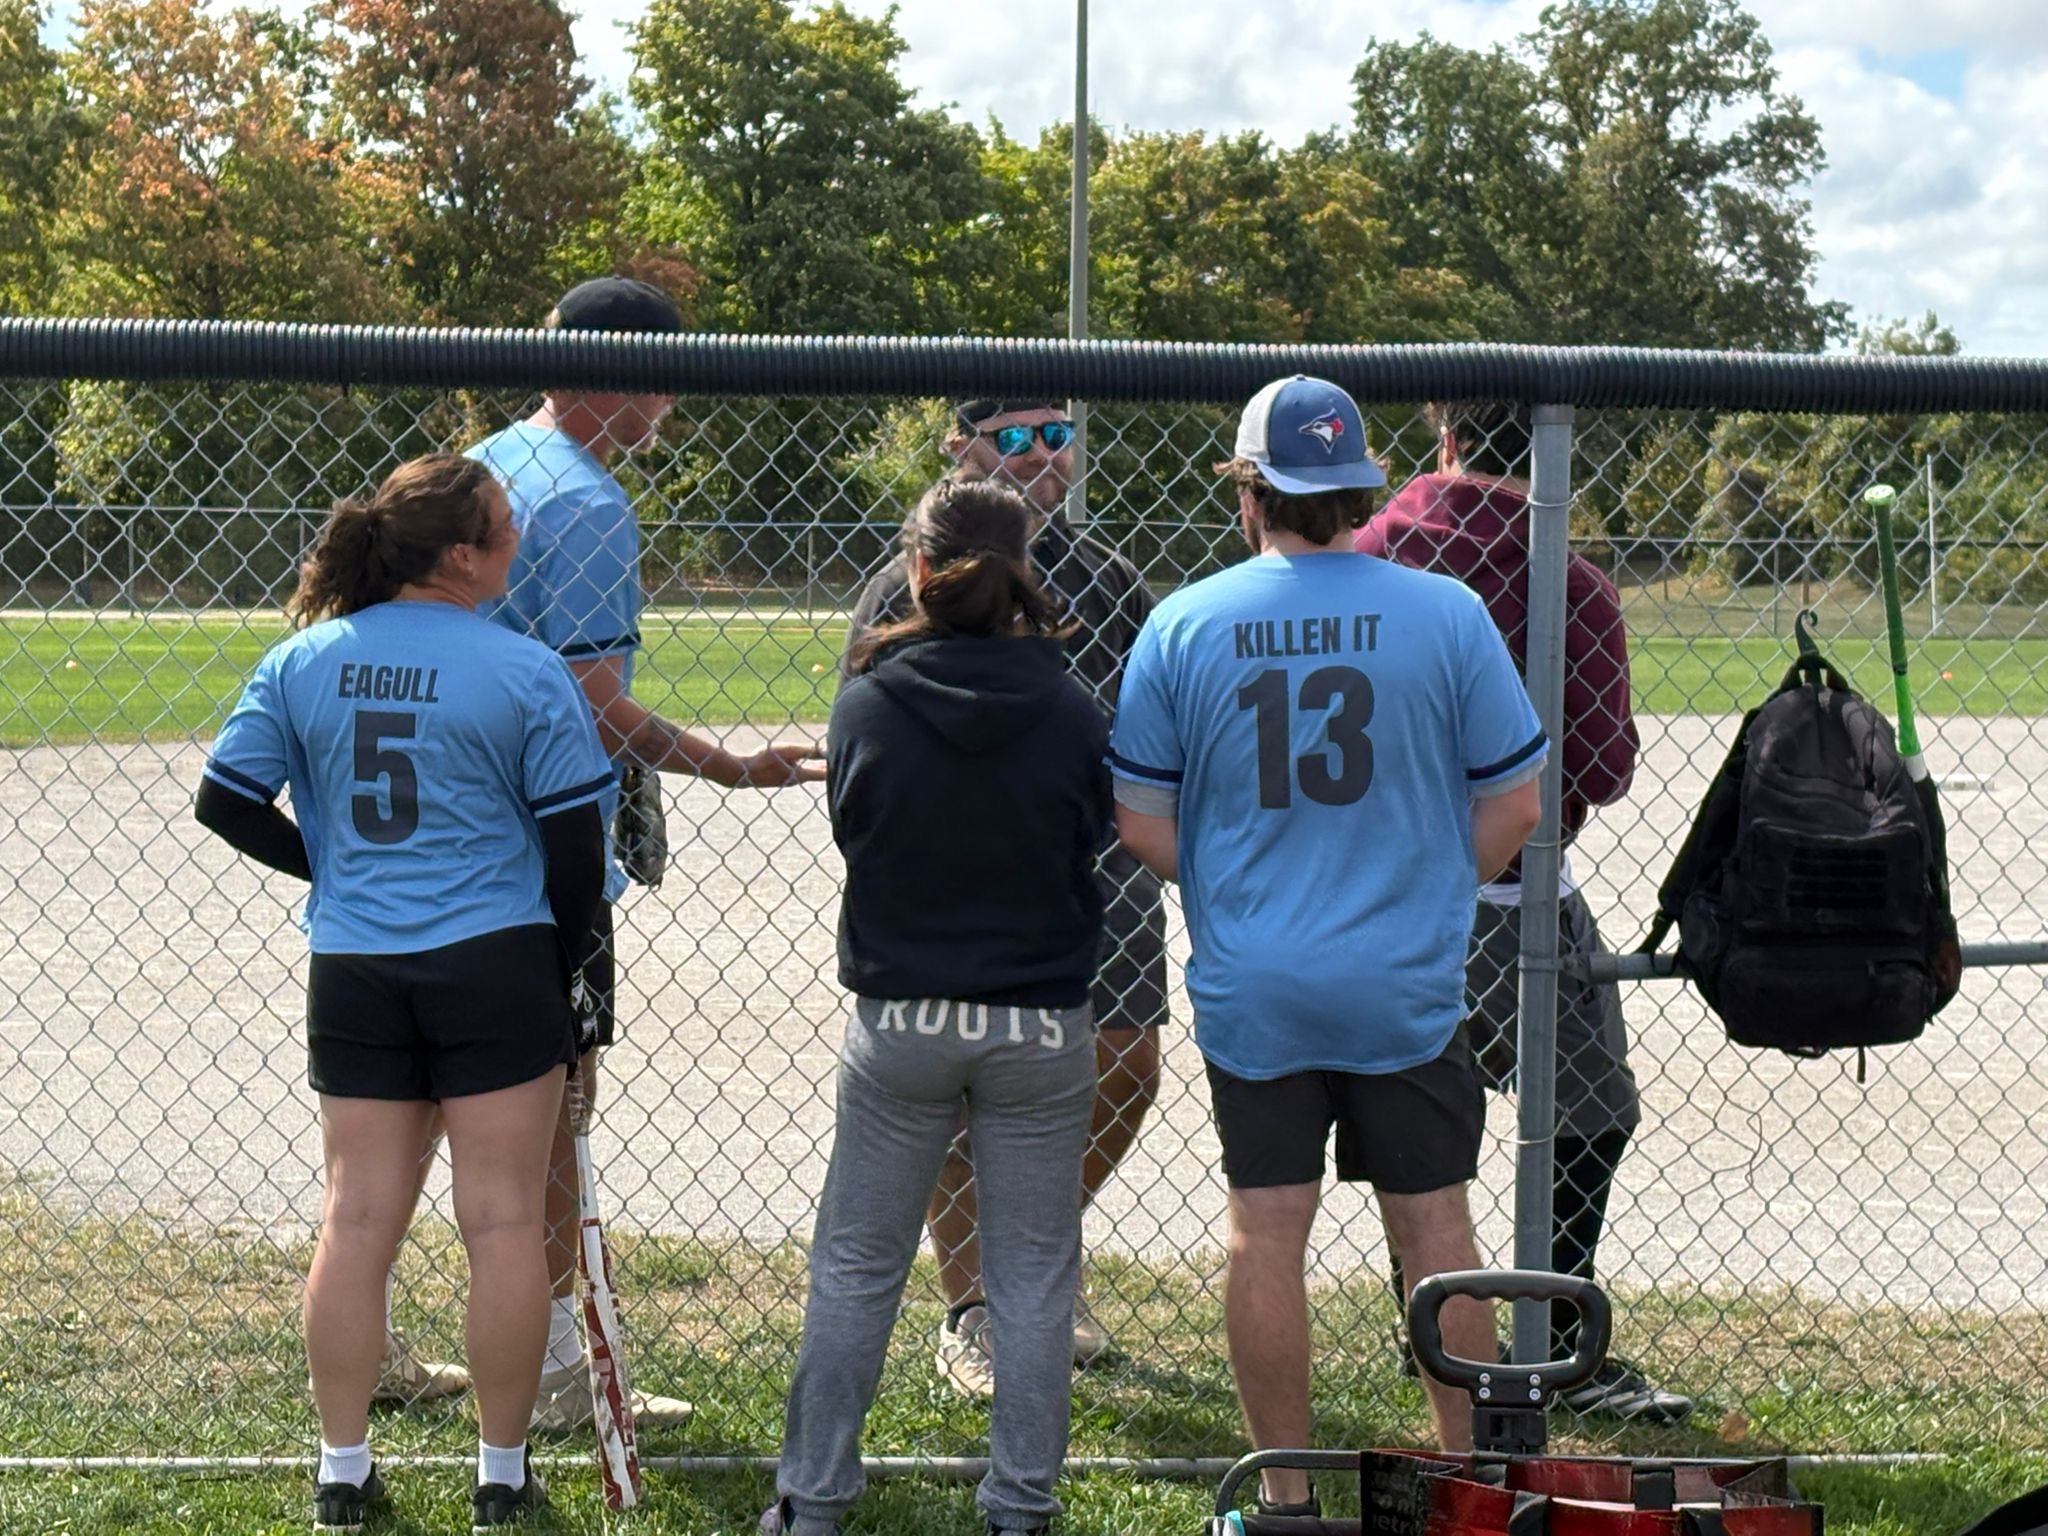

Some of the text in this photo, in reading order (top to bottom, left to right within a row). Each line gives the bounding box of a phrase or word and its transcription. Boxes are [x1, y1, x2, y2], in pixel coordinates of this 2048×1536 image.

[1235, 614, 1382, 659] KILLEN IT
[338, 663, 439, 703] EAGULL
[351, 710, 420, 845] 5
[1238, 665, 1375, 809] 13
